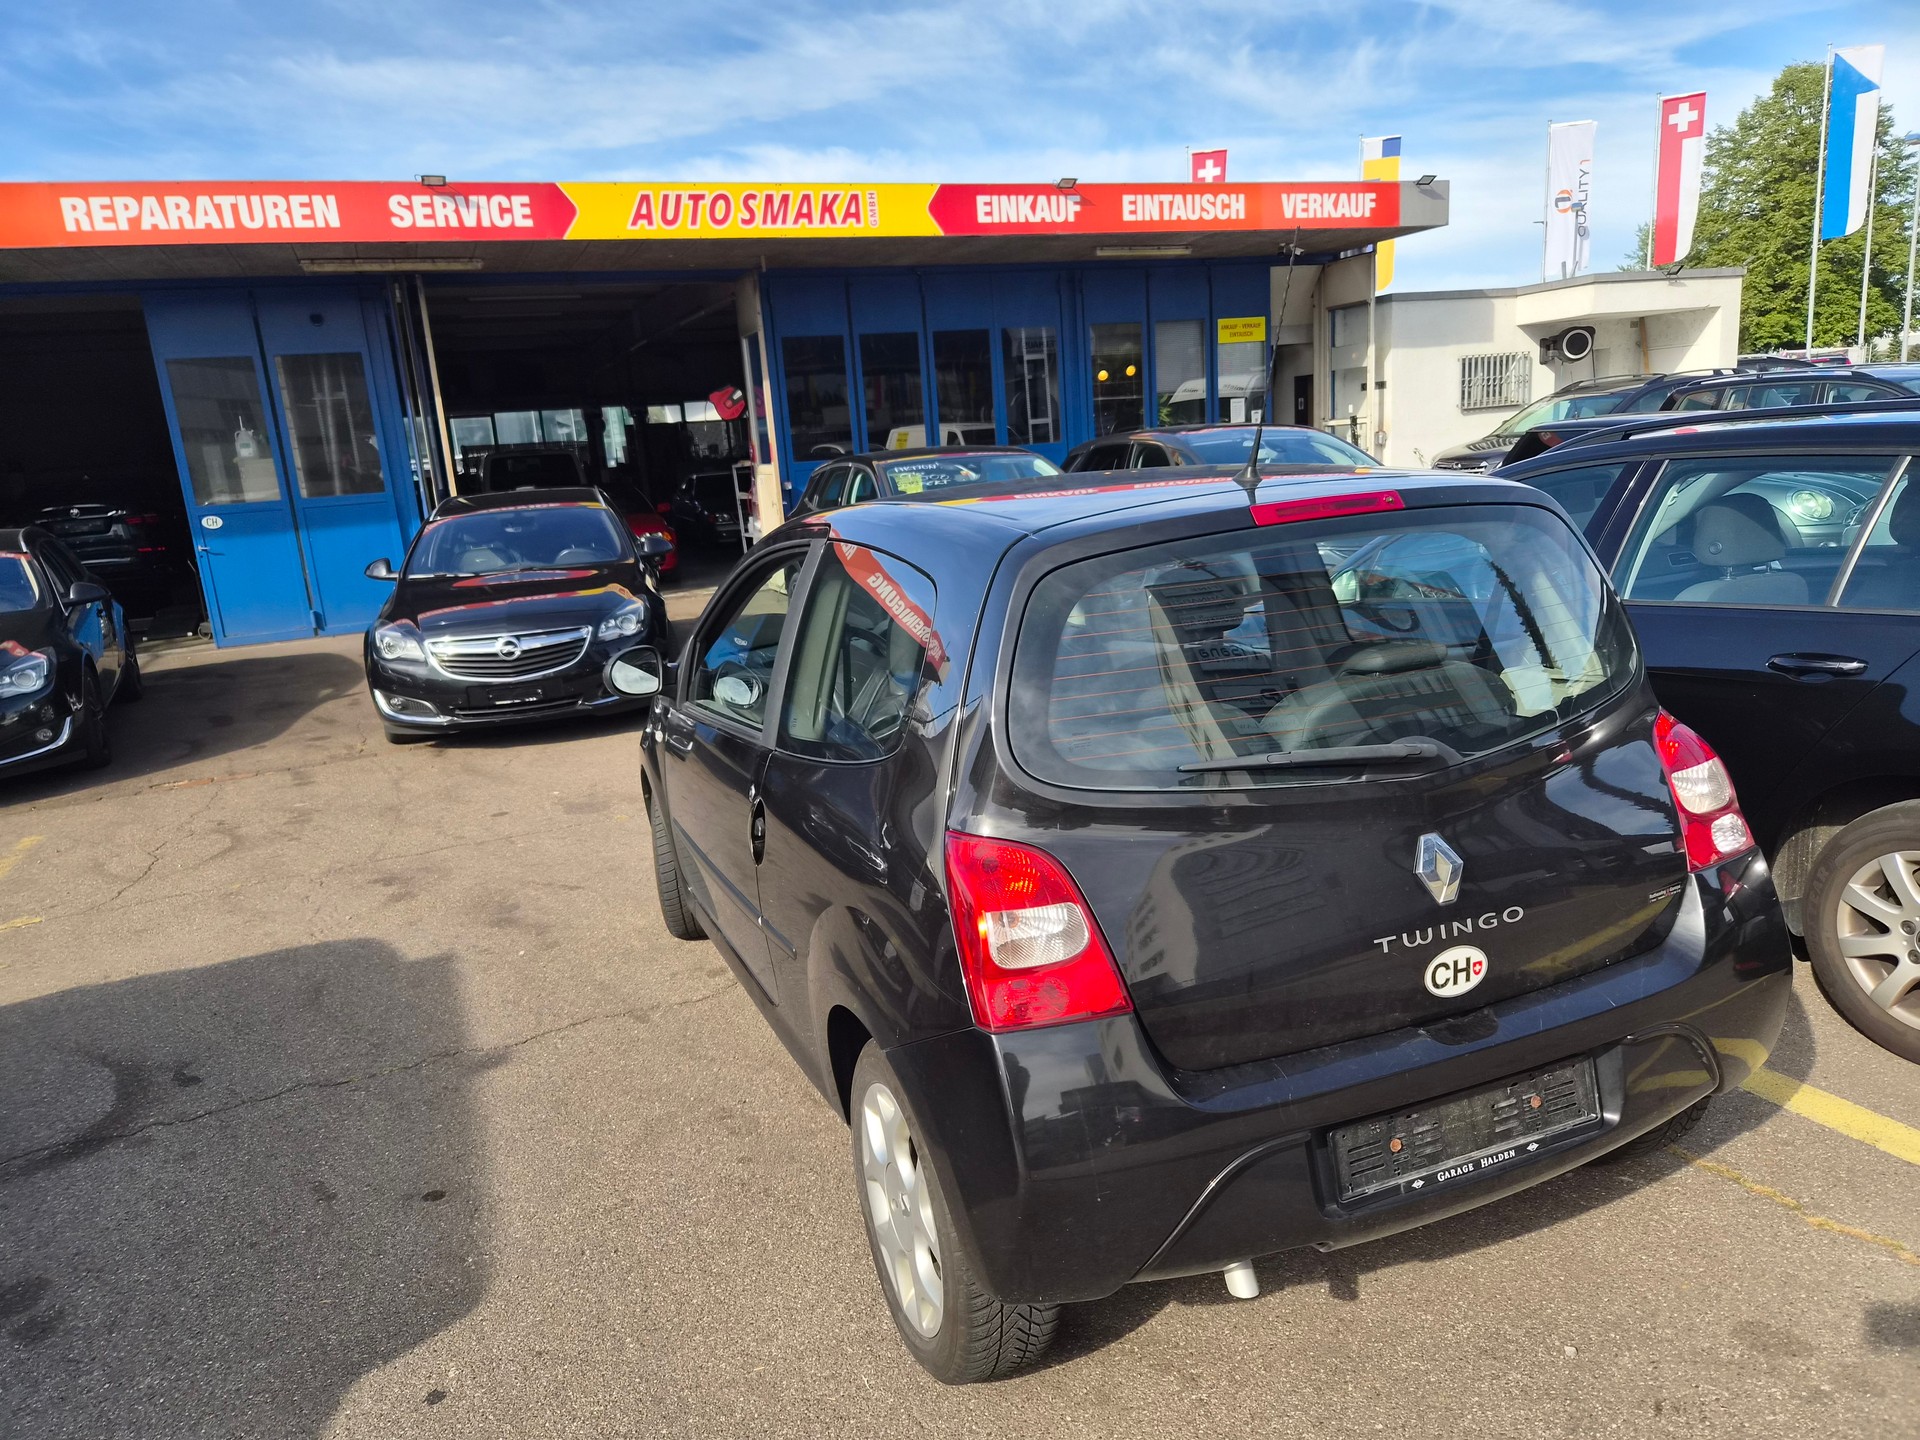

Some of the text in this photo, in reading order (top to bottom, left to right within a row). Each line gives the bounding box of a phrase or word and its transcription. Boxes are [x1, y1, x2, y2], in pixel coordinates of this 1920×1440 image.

[58, 194, 340, 232] REPARATUREN
[388, 194, 534, 229] SERVICE
[629, 191, 863, 229] AUTO SMAKA
[869, 191, 877, 227] GMBH
[976, 194, 1081, 224] EINKAUF
[1122, 194, 1246, 222] EINTAUSCH
[1281, 193, 1377, 219] VERKAUF
[1373, 905, 1525, 954] TWINGO
[1430, 957, 1472, 990] CH
